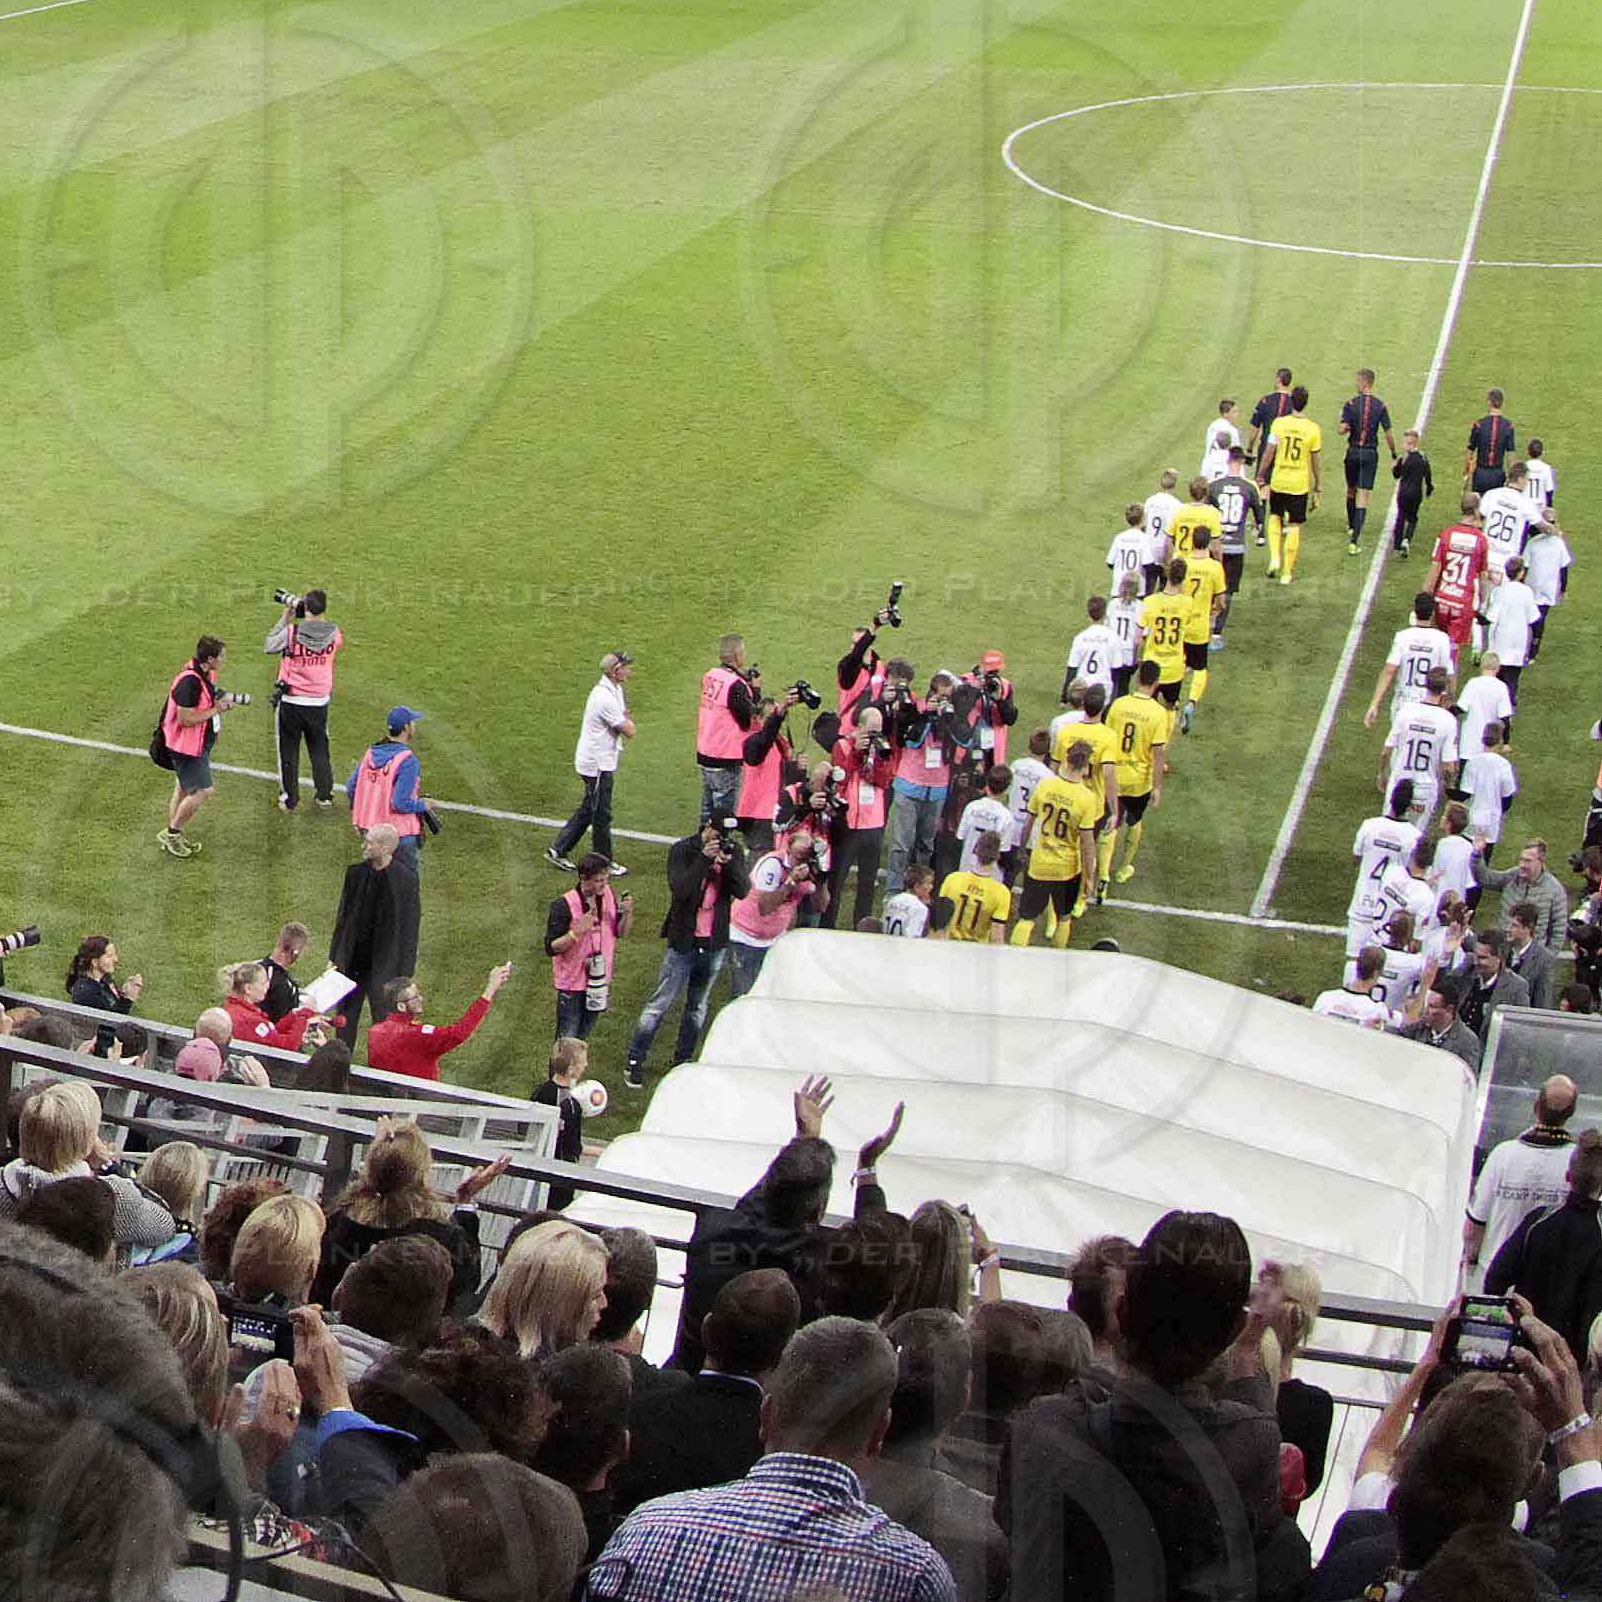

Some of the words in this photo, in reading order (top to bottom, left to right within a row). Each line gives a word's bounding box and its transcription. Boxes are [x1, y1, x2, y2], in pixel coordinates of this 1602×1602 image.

[1284, 436, 1302, 461] 15
[1487, 510, 1516, 543] 26
[1120, 547, 1138, 568] 10
[1442, 552, 1472, 586] 31
[1154, 616, 1181, 645] 33
[1086, 650, 1098, 674] 6
[1121, 721, 1136, 753] 8
[1404, 739, 1432, 772] 16
[1041, 801, 1070, 839] 26
[956, 892, 984, 932] 11
